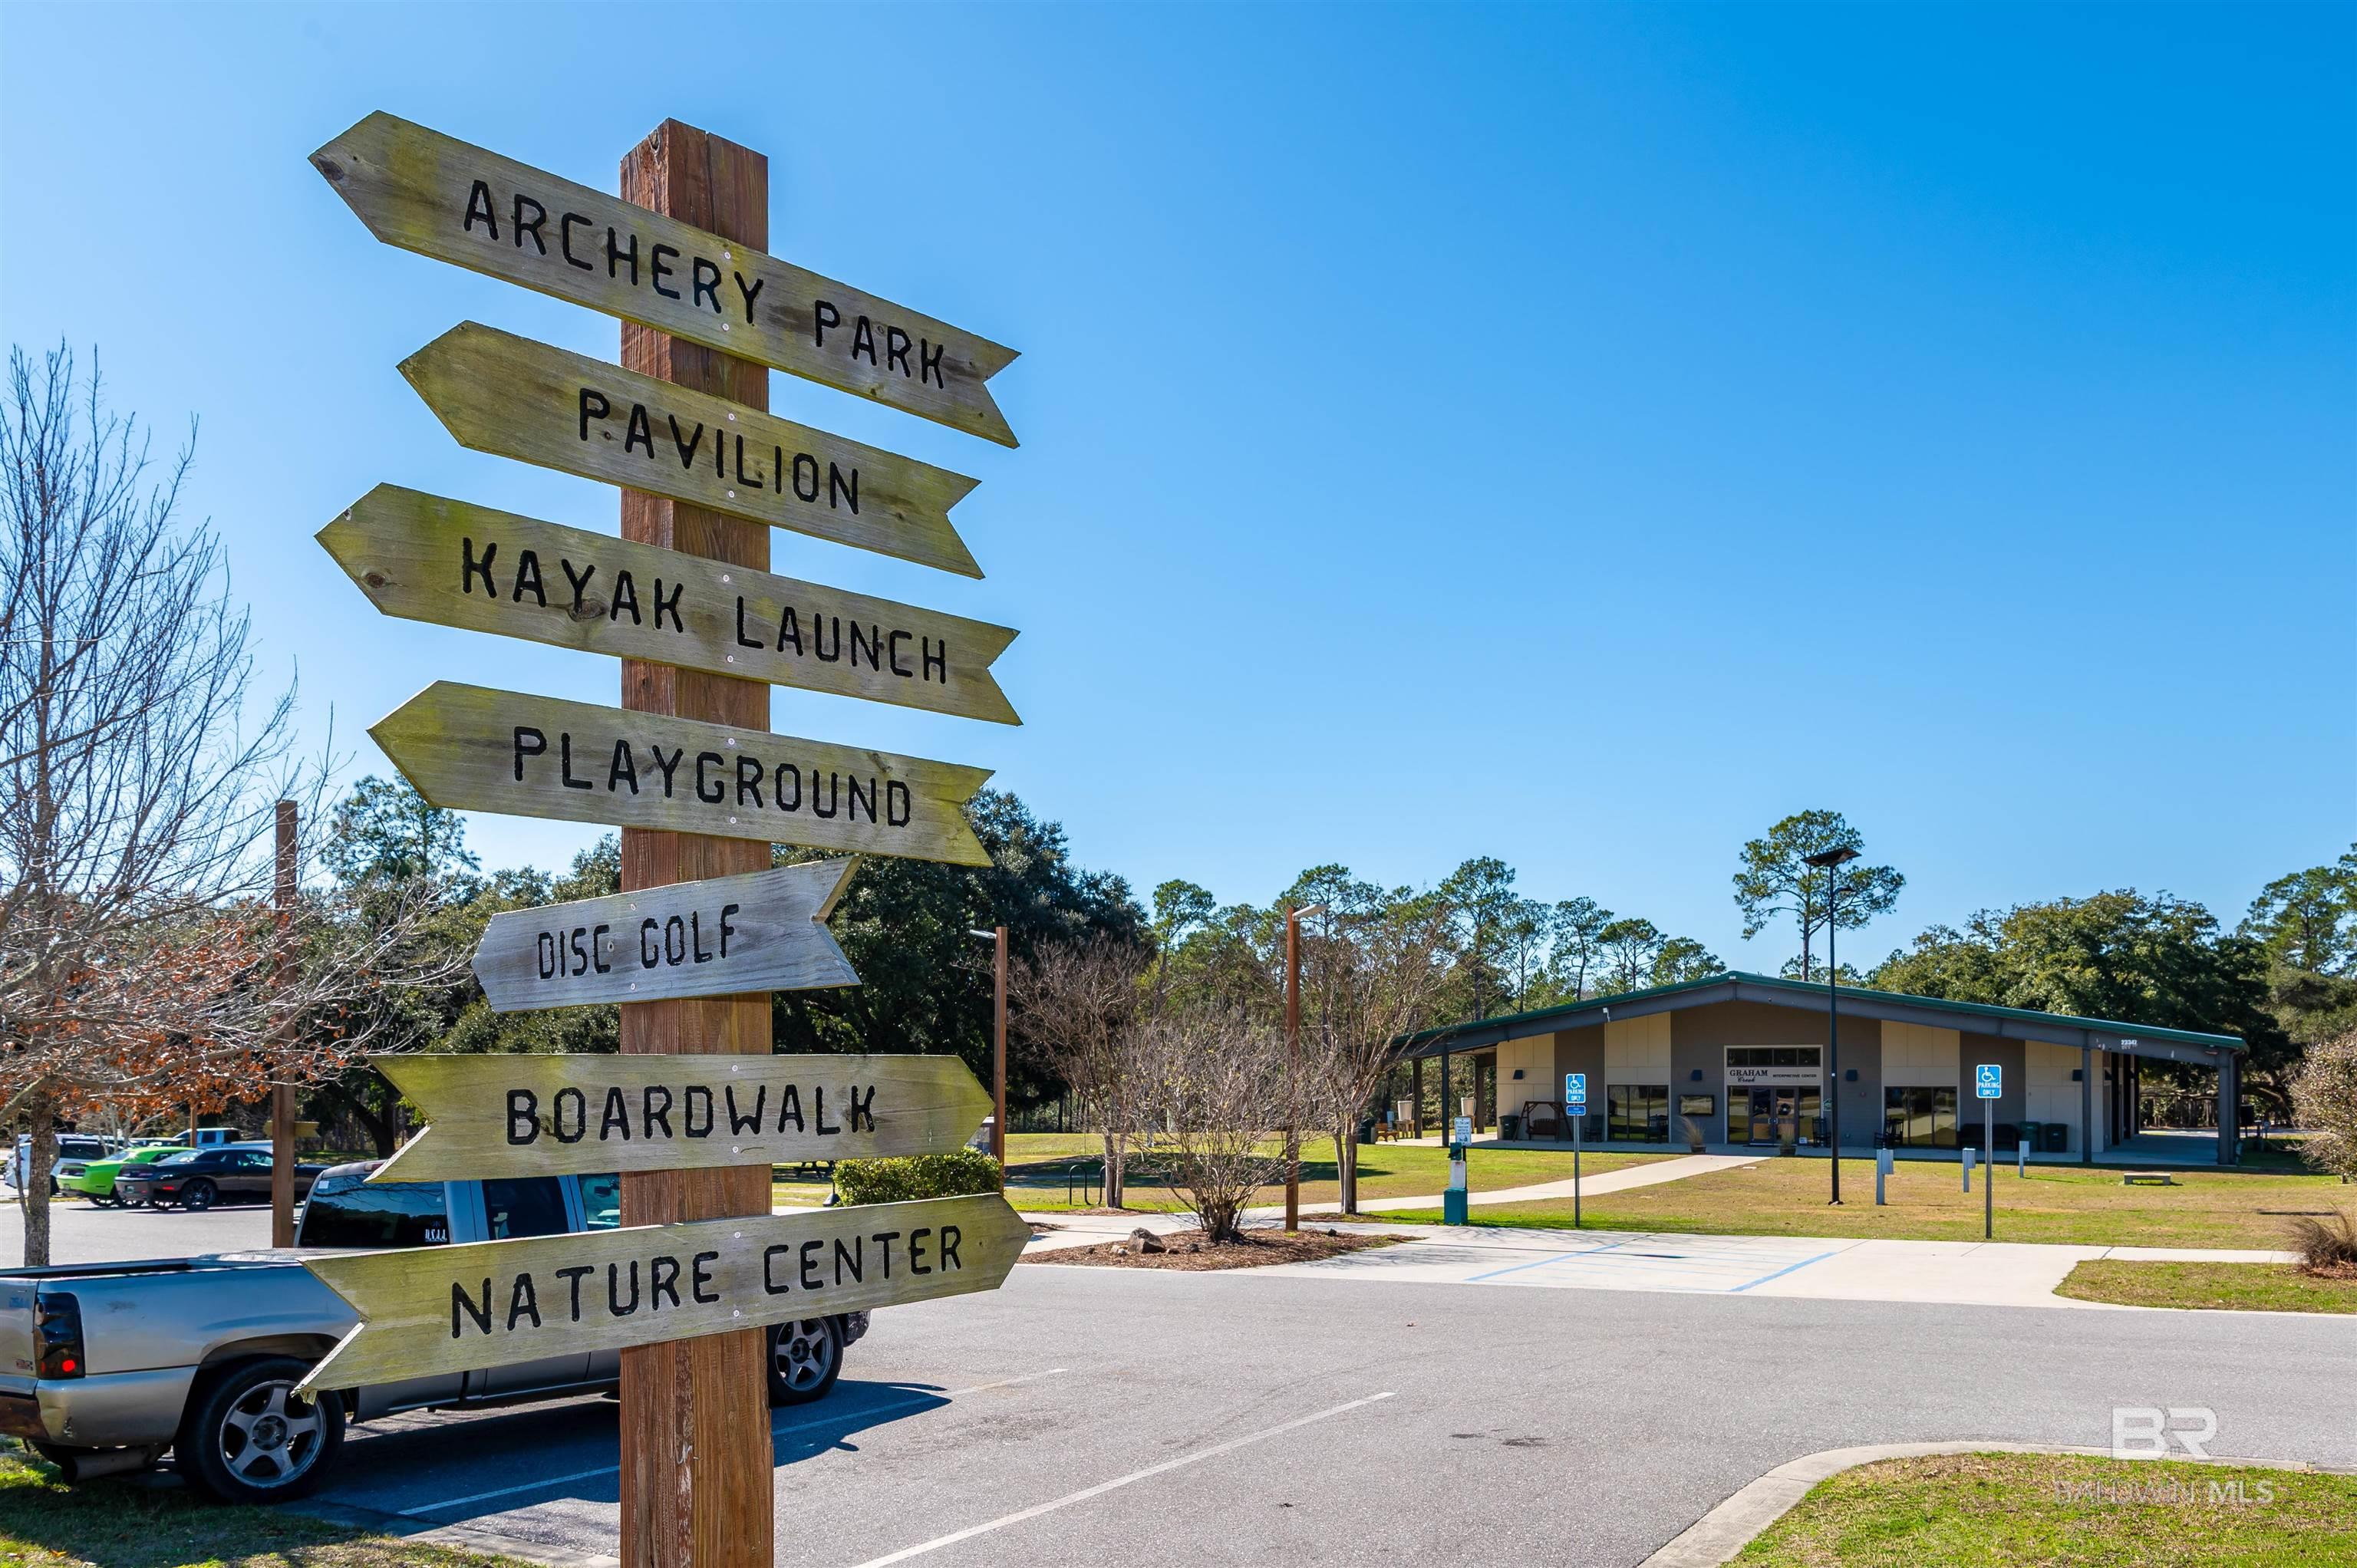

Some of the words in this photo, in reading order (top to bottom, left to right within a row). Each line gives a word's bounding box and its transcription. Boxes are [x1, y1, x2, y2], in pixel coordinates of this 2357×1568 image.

[464, 180, 763, 324] ARCHERY
[815, 300, 945, 389] PARK
[579, 387, 859, 516] PAVILION
[462, 537, 684, 634] KAYAK
[736, 596, 946, 685] LAUNCH
[514, 726, 911, 828] PLAYGROUND
[538, 924, 611, 980] DISC
[641, 904, 739, 969] GOLF
[506, 1085, 875, 1145] BOARDWALK
[452, 1251, 719, 1338] NATURE
[764, 1226, 961, 1295] CENTER
